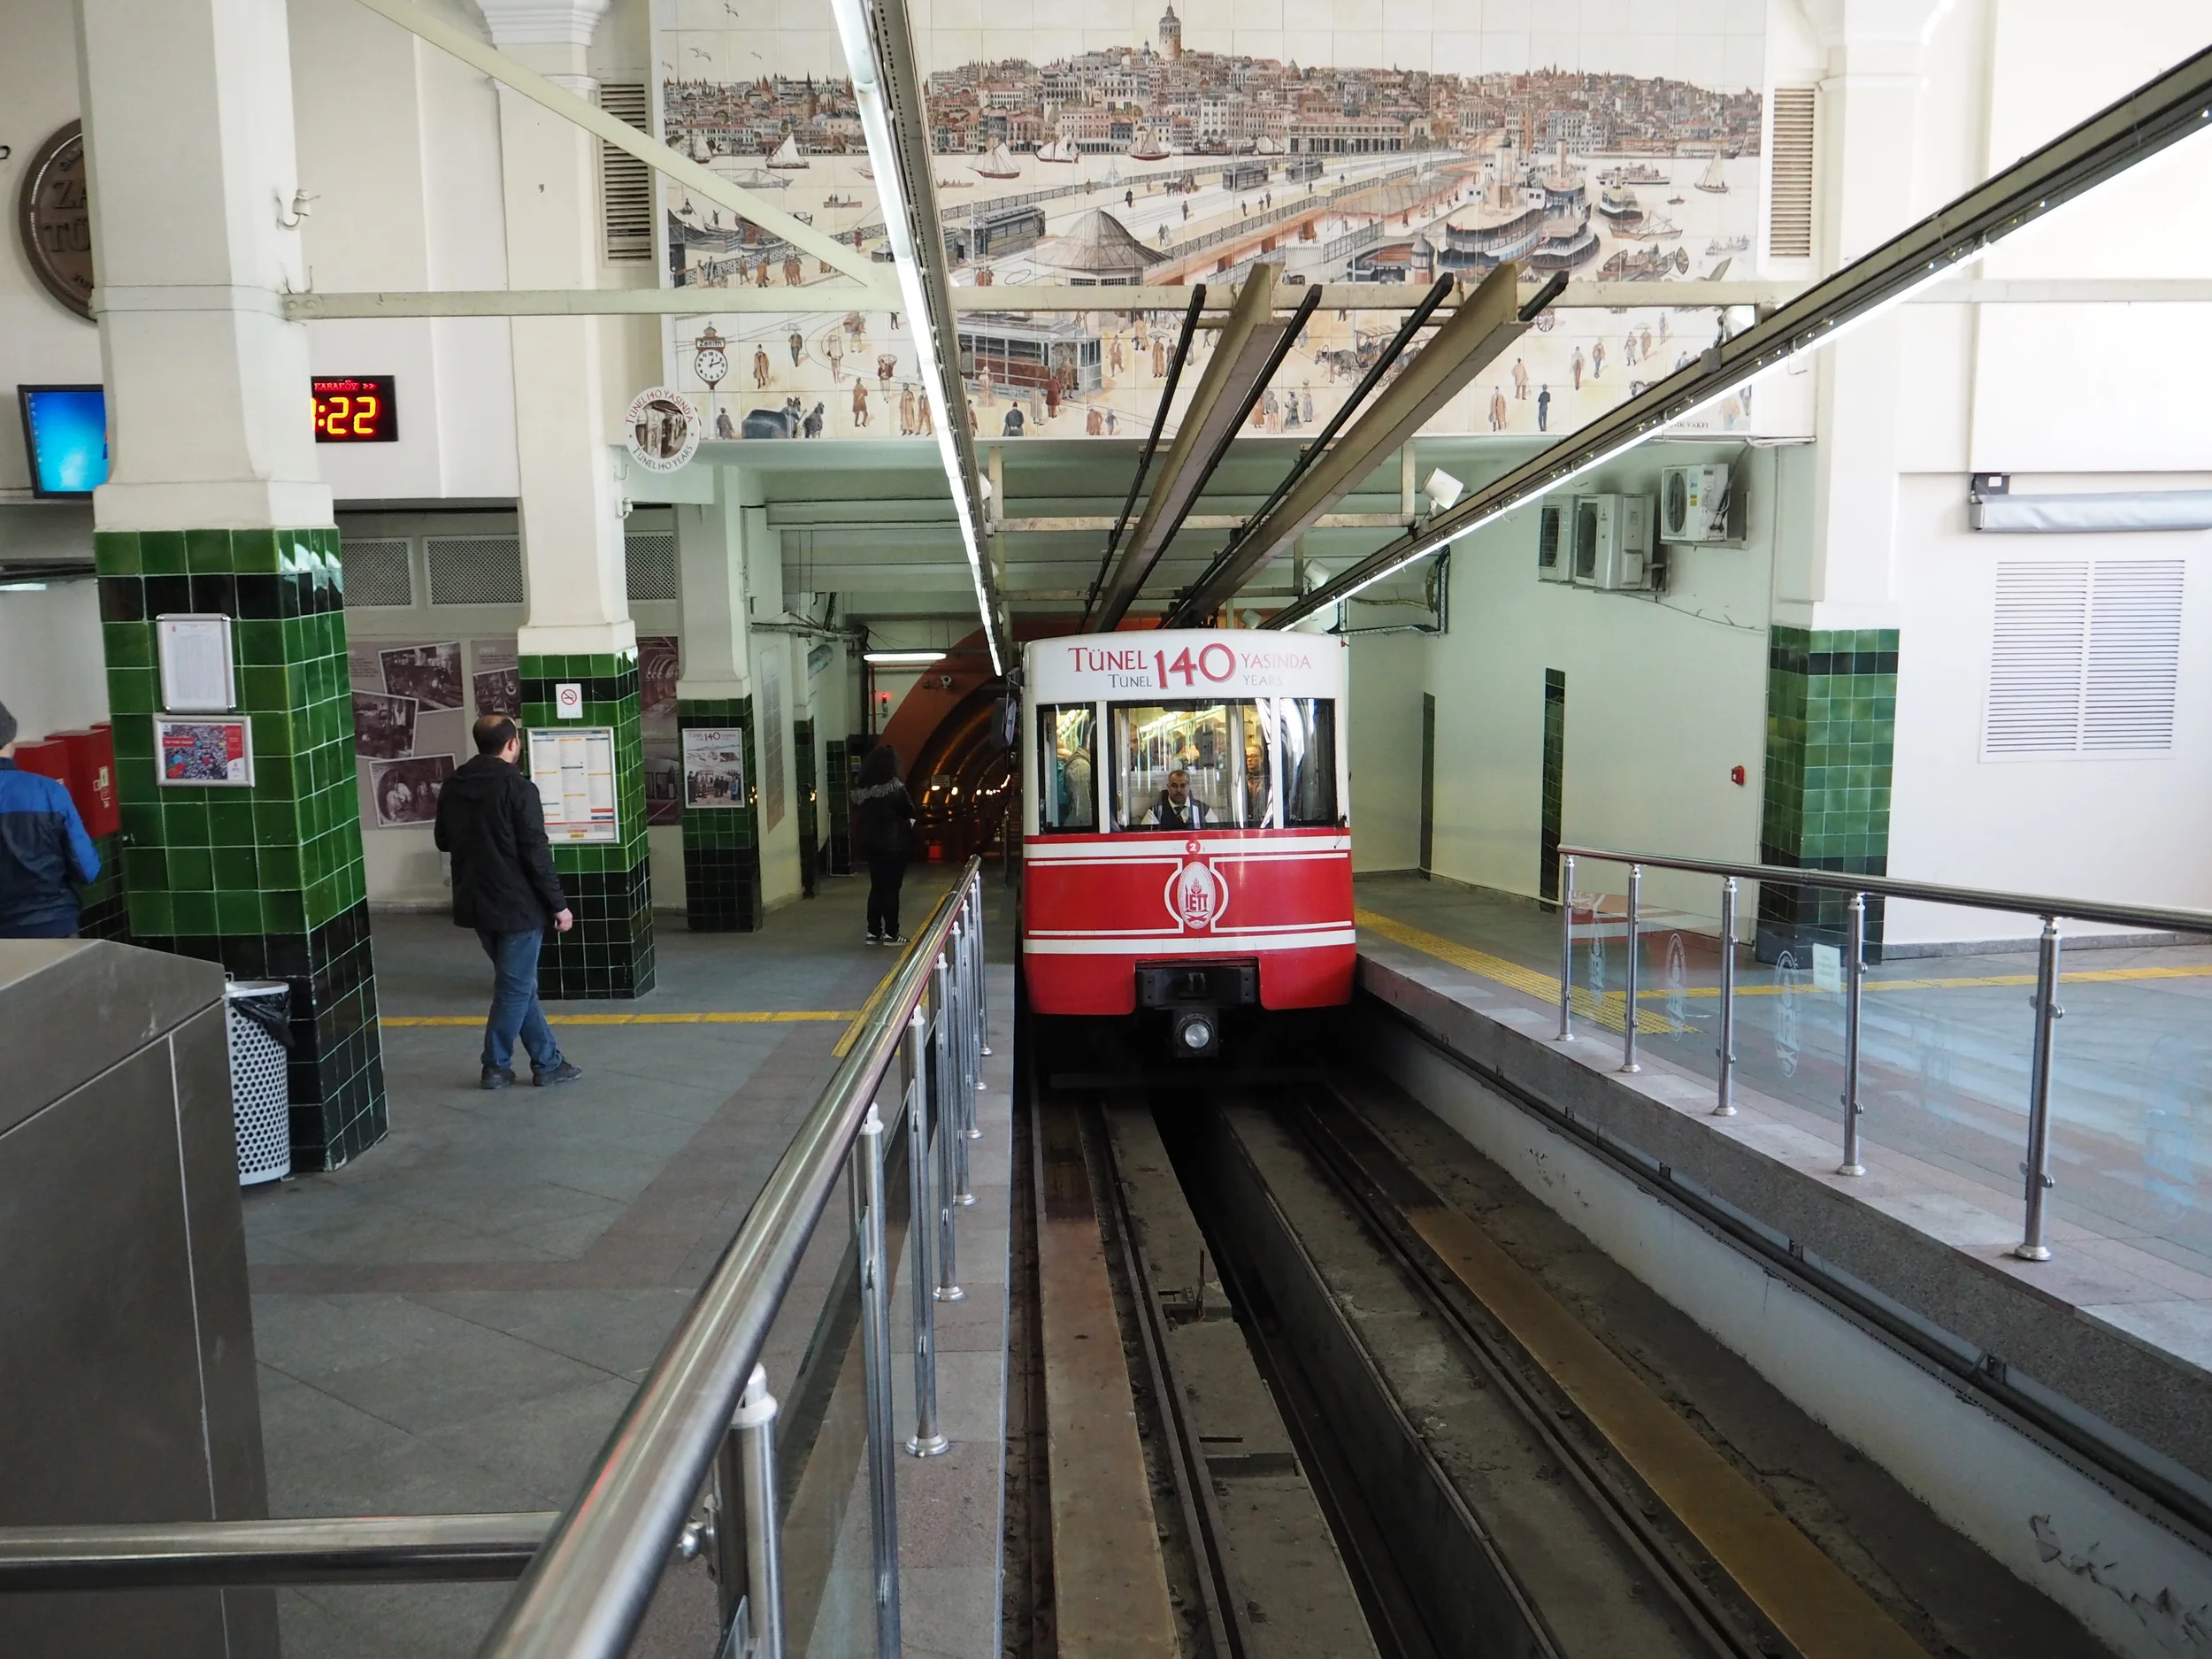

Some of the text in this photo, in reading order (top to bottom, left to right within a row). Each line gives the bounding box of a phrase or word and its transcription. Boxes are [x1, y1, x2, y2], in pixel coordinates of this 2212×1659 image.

[647, 389, 662, 401] 140
[657, 461, 672, 471] 140
[672, 445, 694, 467] YEARS
[1067, 642, 1311, 690] TÜNEL 140 YAŞINDA
[1108, 673, 1283, 688] TÜNEL YEARS
[704, 732, 721, 741] 140
[1189, 842, 1197, 851] 2
